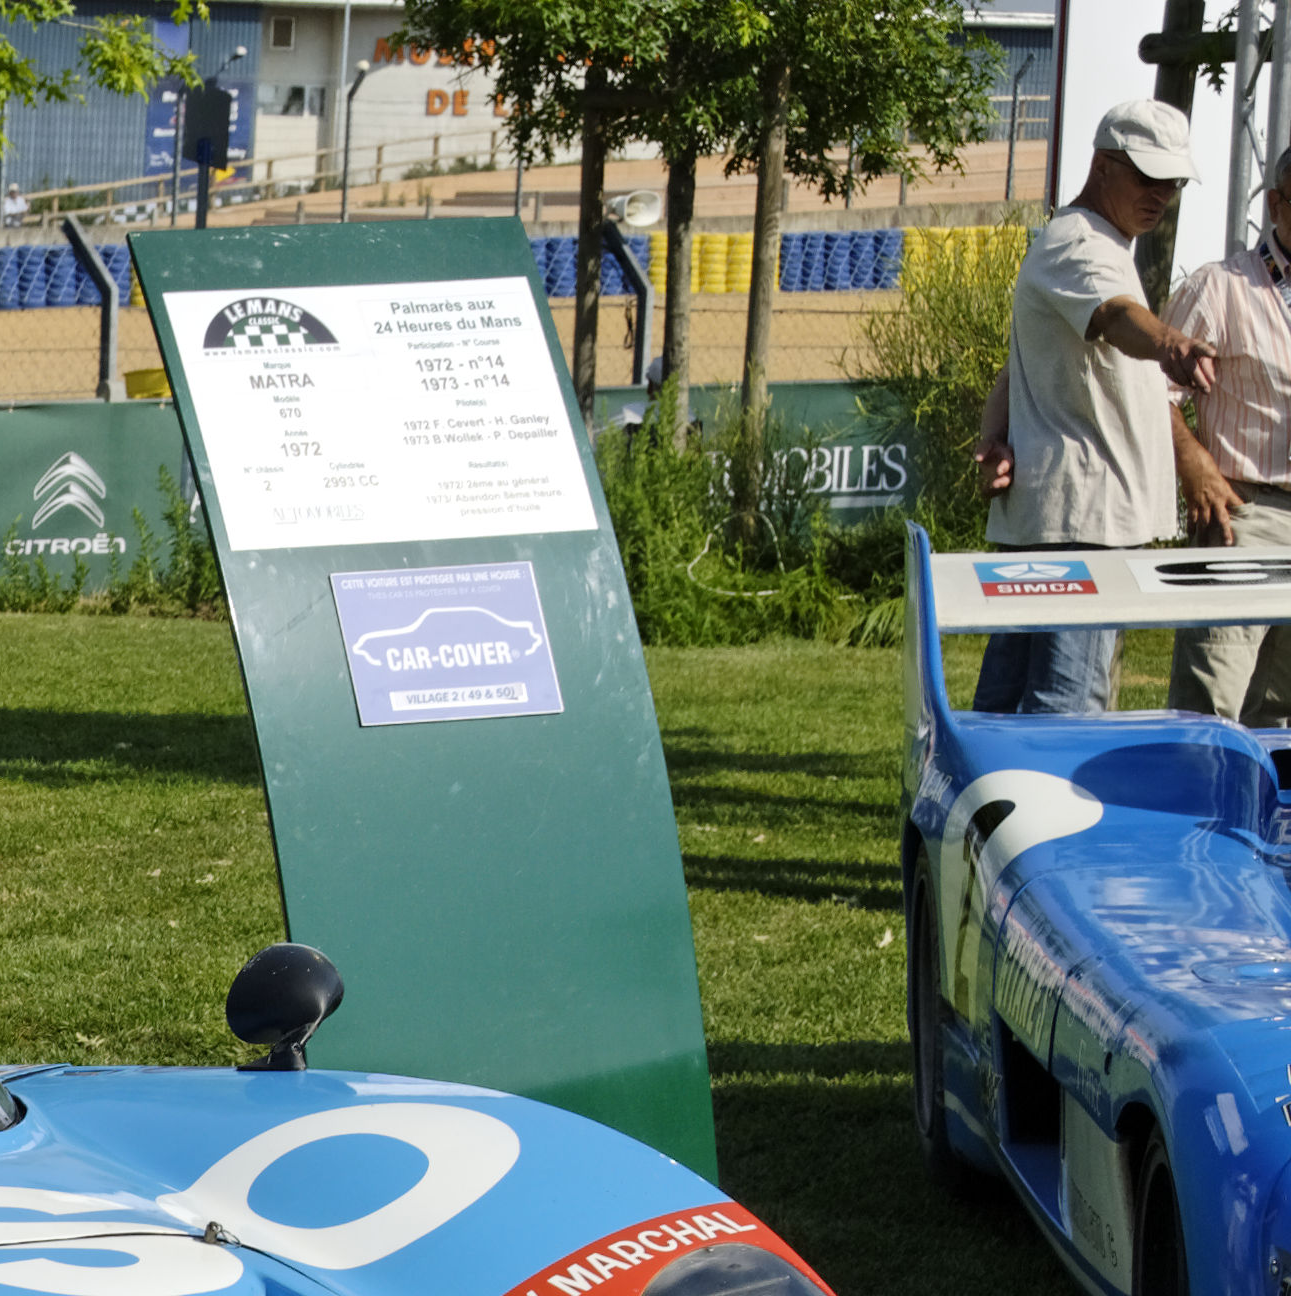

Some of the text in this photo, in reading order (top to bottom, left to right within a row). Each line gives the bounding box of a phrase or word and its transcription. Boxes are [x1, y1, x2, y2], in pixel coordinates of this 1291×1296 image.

[426, 90, 469, 117] DE
[390, 299, 496, 315] Palmarès aux
[248, 316, 280, 326] CLASSIC
[374, 315, 523, 334] 24 Heures du Mans
[415, 357, 455, 373] 1972
[249, 373, 315, 390] MATRA
[420, 376, 460, 392] 1973
[403, 419, 430, 431] 1972
[447, 417, 486, 429] Cevert
[510, 414, 550, 425] Ganley
[403, 434, 430, 446] 1973
[280, 441, 323, 458] 1972
[263, 479, 272, 492] 2
[323, 474, 380, 489] 2993 CC
[367, 578, 399, 588] VOITURE
[996, 581, 1084, 595] SIMCA
[406, 690, 449, 704] VILLAGE
[452, 690, 460, 702] 2
[468, 688, 482, 701] 49
